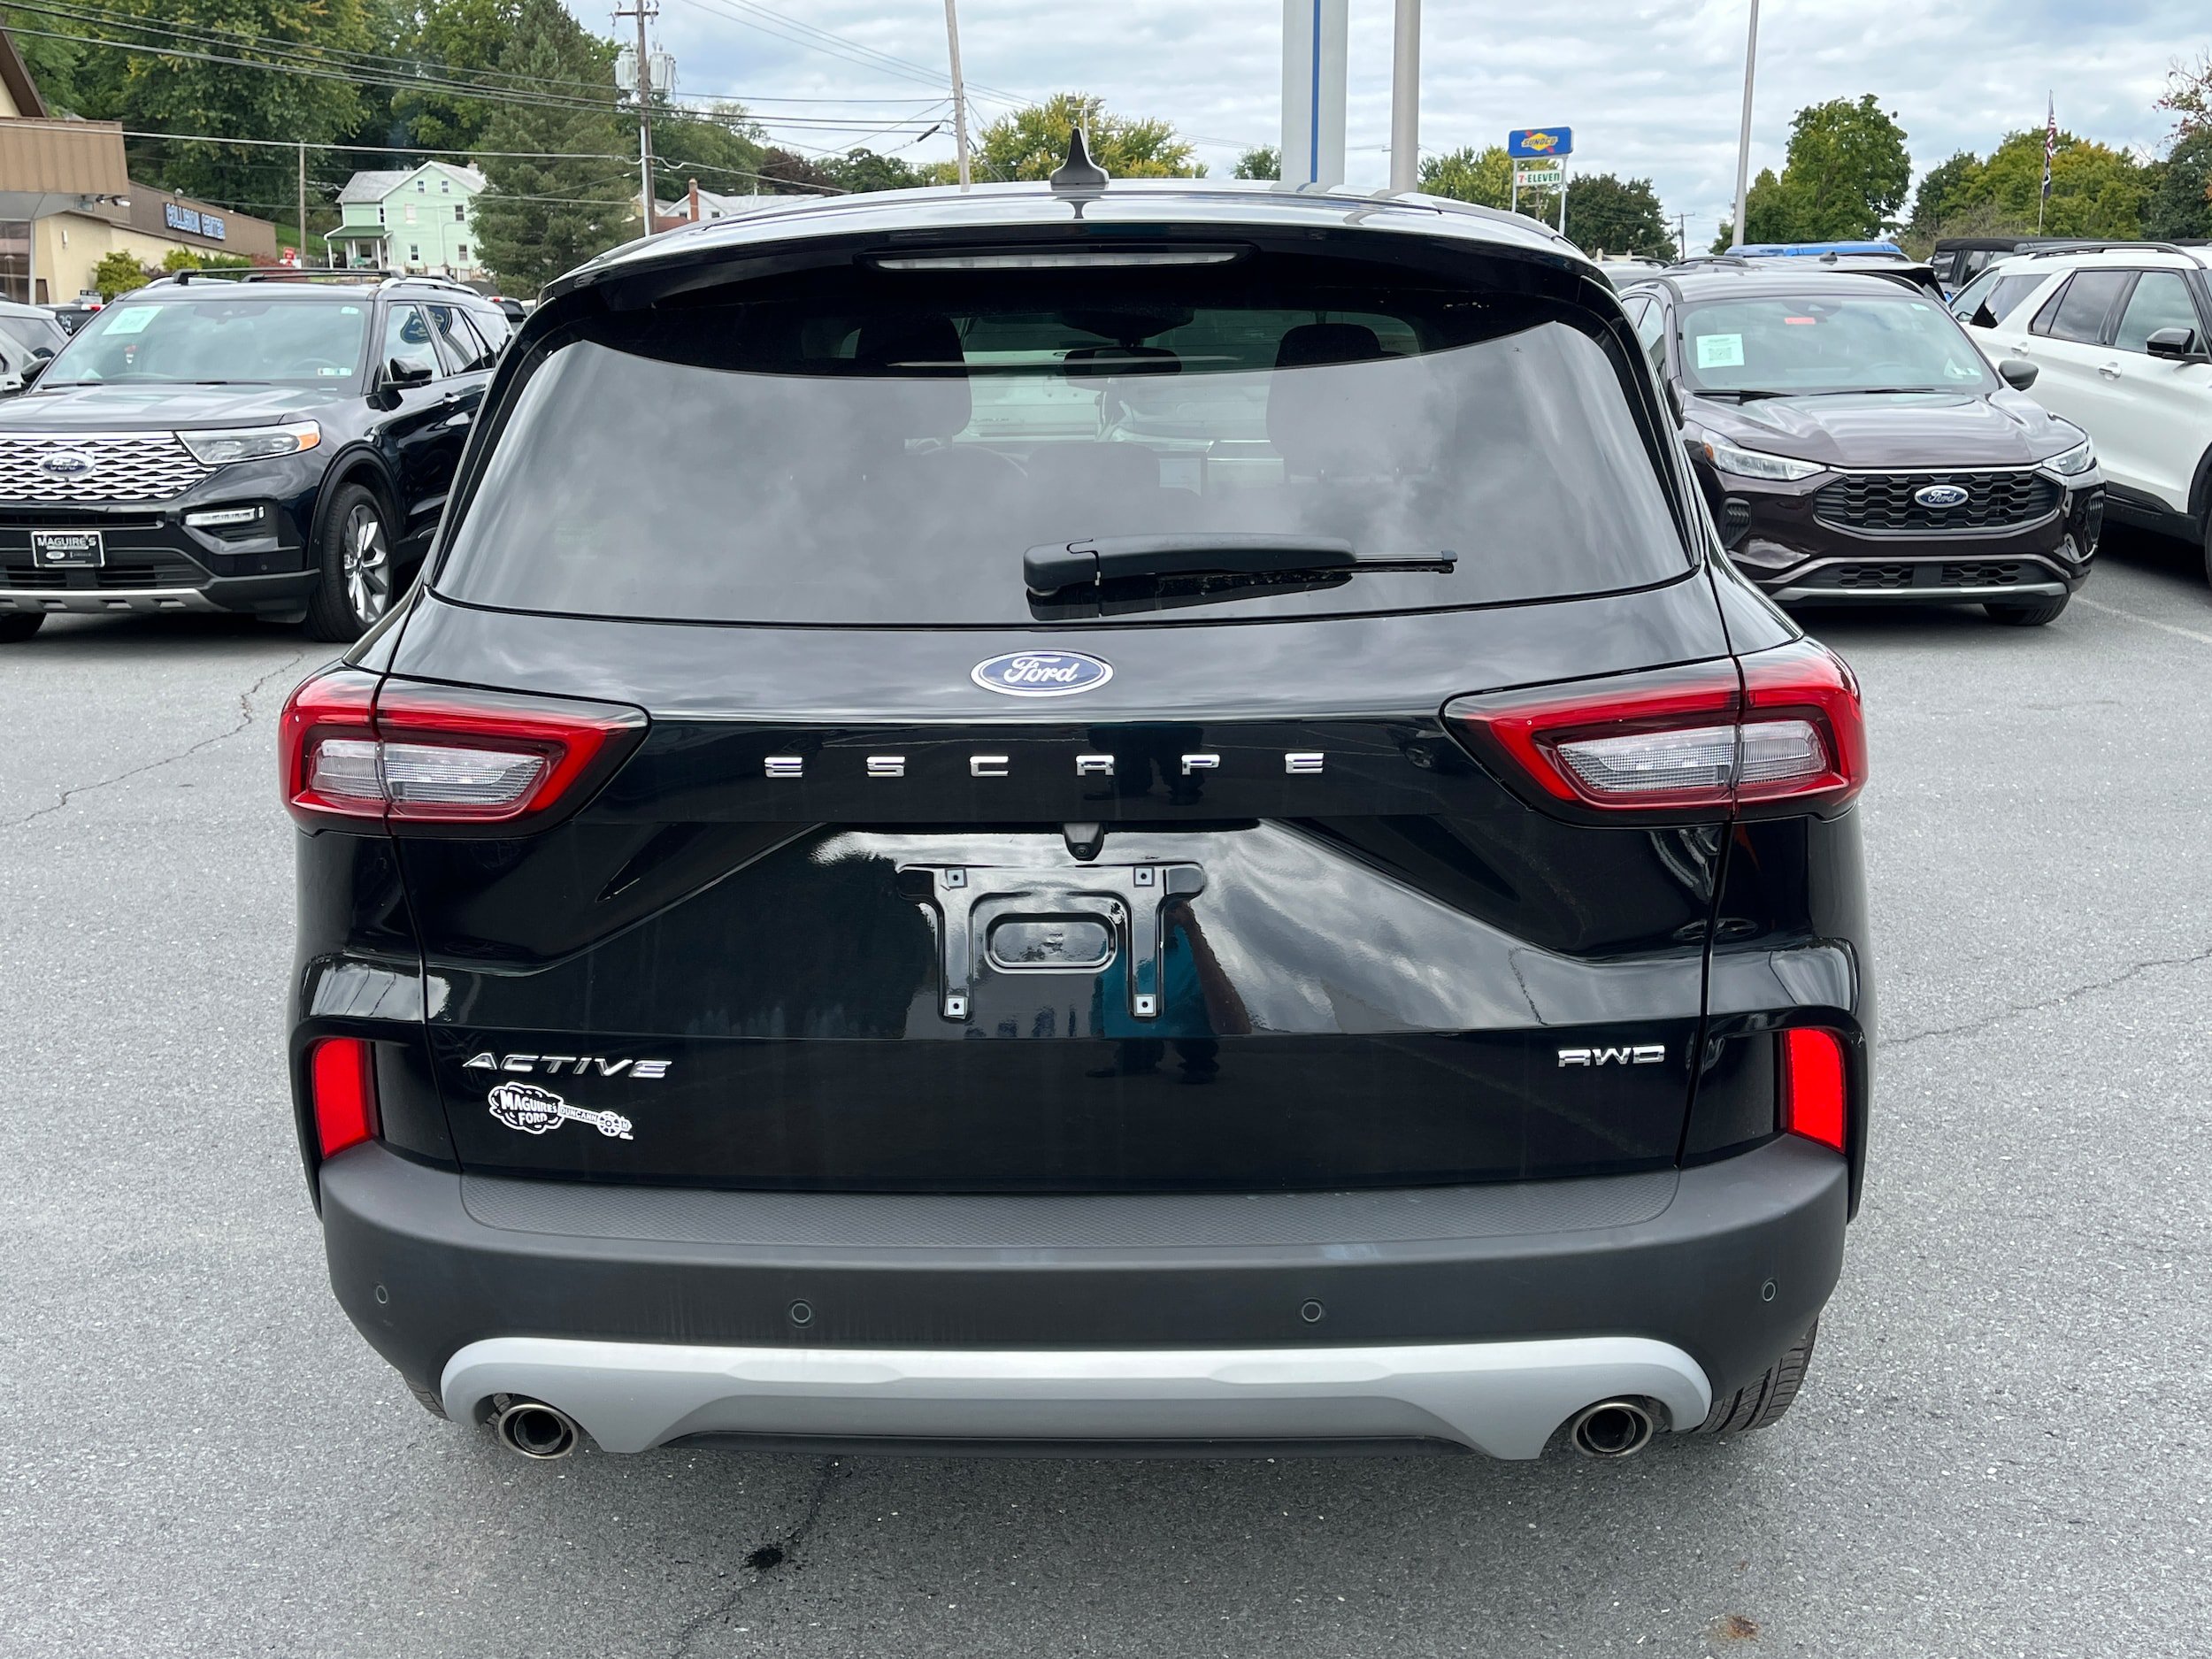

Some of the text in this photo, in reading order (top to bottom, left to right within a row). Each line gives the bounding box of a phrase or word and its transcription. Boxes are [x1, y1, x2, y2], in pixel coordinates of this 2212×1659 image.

[1523, 137, 1557, 146] SUNOCO
[1927, 489, 1957, 503] Ford
[37, 537, 96, 546] MAGUIRE'S
[1003, 656, 1079, 683] Ford
[764, 752, 1325, 778] ESCAPE
[462, 1052, 672, 1079] ACTIVE
[1558, 1045, 1665, 1068] AWD
[518, 1111, 549, 1126] FORD
